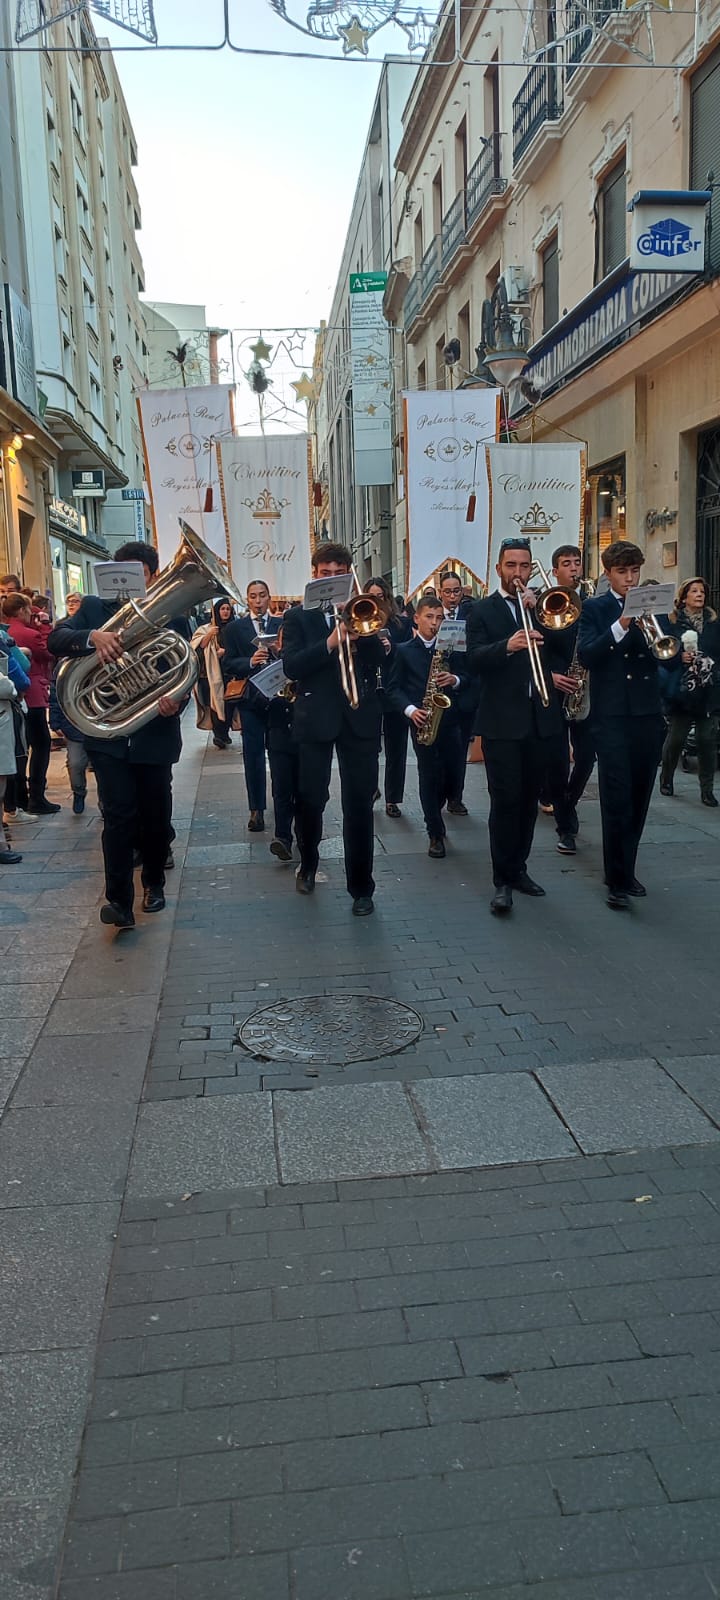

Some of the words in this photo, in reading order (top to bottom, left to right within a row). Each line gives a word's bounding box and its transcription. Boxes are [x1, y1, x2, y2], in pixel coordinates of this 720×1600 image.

[553, 286, 627, 377] INMOBILIARIA
[151, 409, 190, 428] Palacio
[193, 406, 225, 422] Real
[416, 412, 457, 430] Palacio
[460, 411, 491, 429] Real
[227, 462, 302, 481] Comitiva
[160, 477, 190, 493] Reyes
[191, 476, 219, 490] Maos
[418, 476, 449, 493] Reyes
[497, 473, 576, 495] Comitiva
[241, 540, 296, 562] Real
